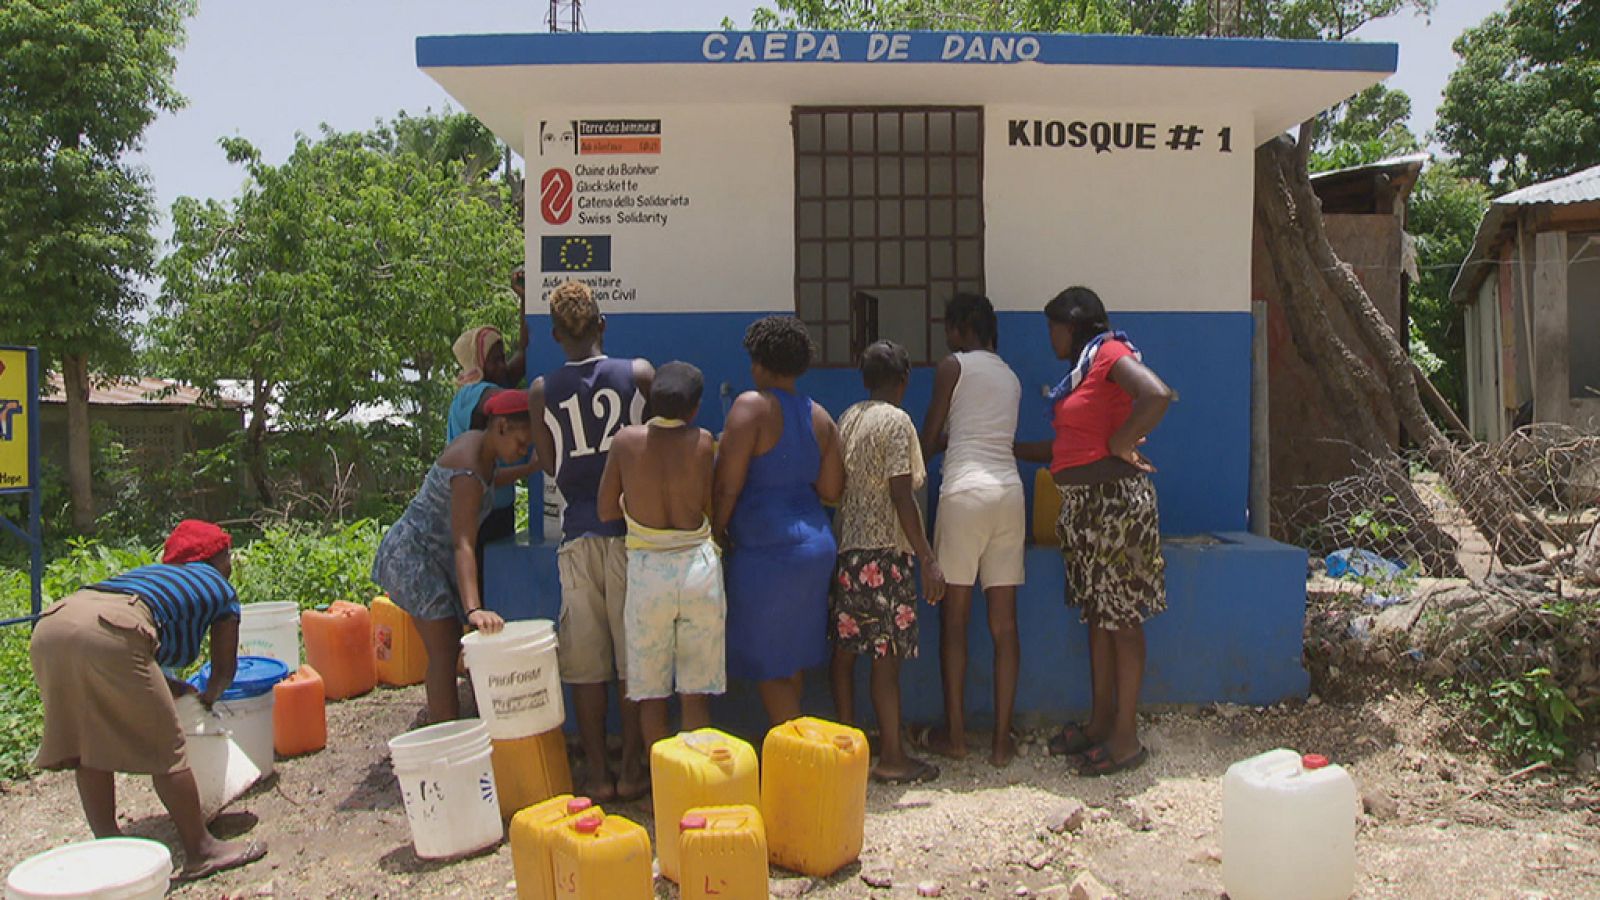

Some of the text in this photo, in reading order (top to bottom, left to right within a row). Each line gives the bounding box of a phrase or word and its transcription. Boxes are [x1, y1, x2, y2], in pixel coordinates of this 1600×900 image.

[702, 33, 1040, 61] CAEPA DE DANO
[581, 121, 603, 134] Terre
[604, 121, 620, 133] des
[1008, 119, 1232, 154] KIOSQUE # 1
[607, 165, 620, 175] du
[621, 163, 659, 175] Bonheur
[578, 196, 613, 209] Catena
[579, 211, 668, 227] Swiss Solidarity
[612, 289, 637, 301] Civil
[559, 388, 621, 457] 12
